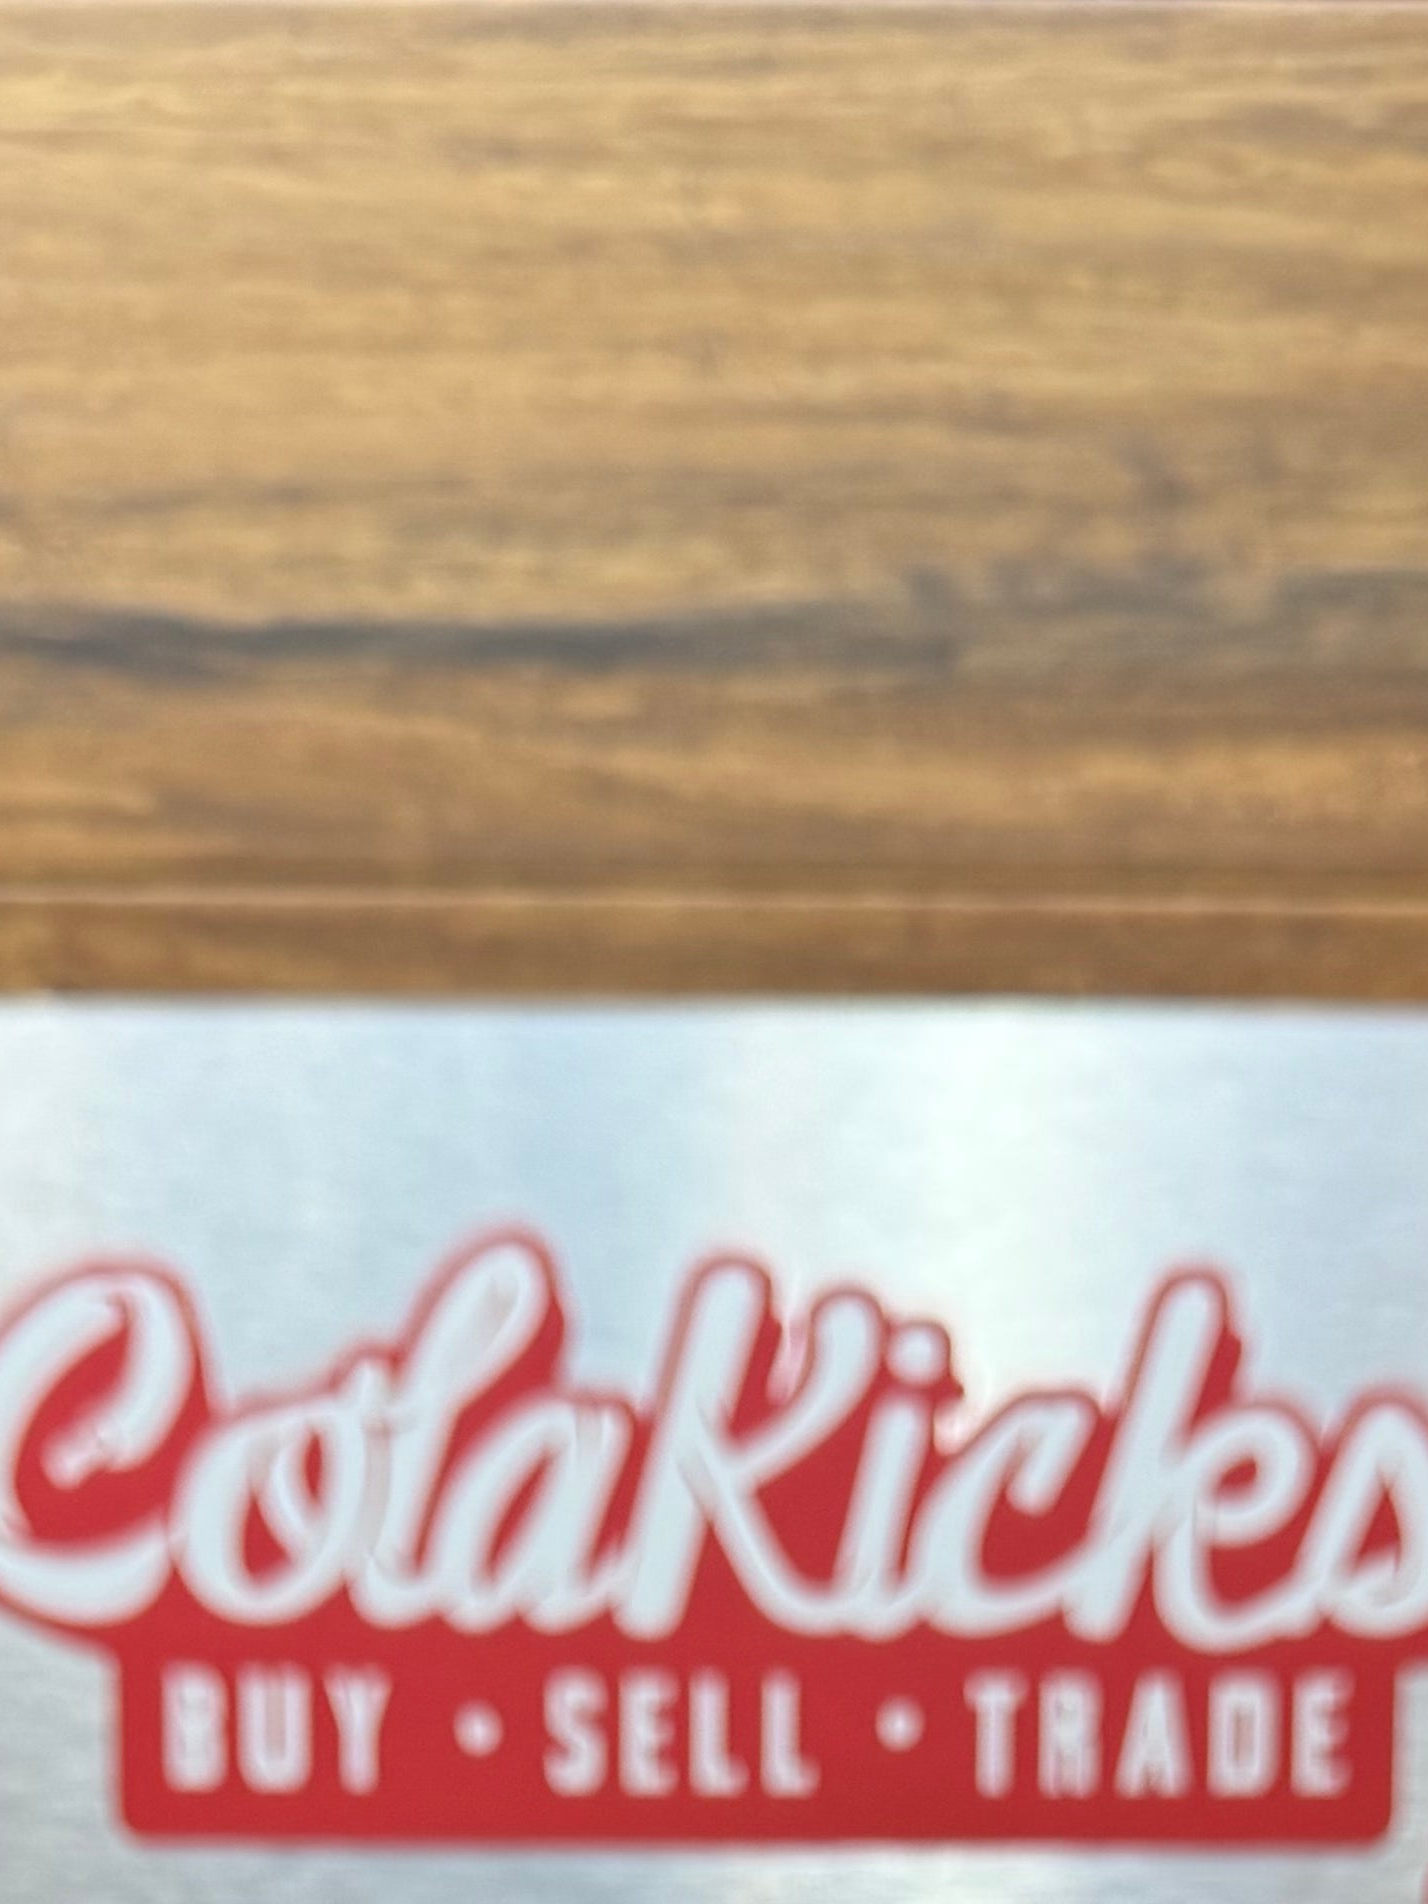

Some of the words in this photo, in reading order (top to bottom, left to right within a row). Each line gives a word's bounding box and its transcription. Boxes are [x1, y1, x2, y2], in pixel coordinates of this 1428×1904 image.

[160, 1660, 392, 1796] BUY
[542, 1664, 820, 1800] SELL
[965, 1668, 1352, 1799] TRADE
